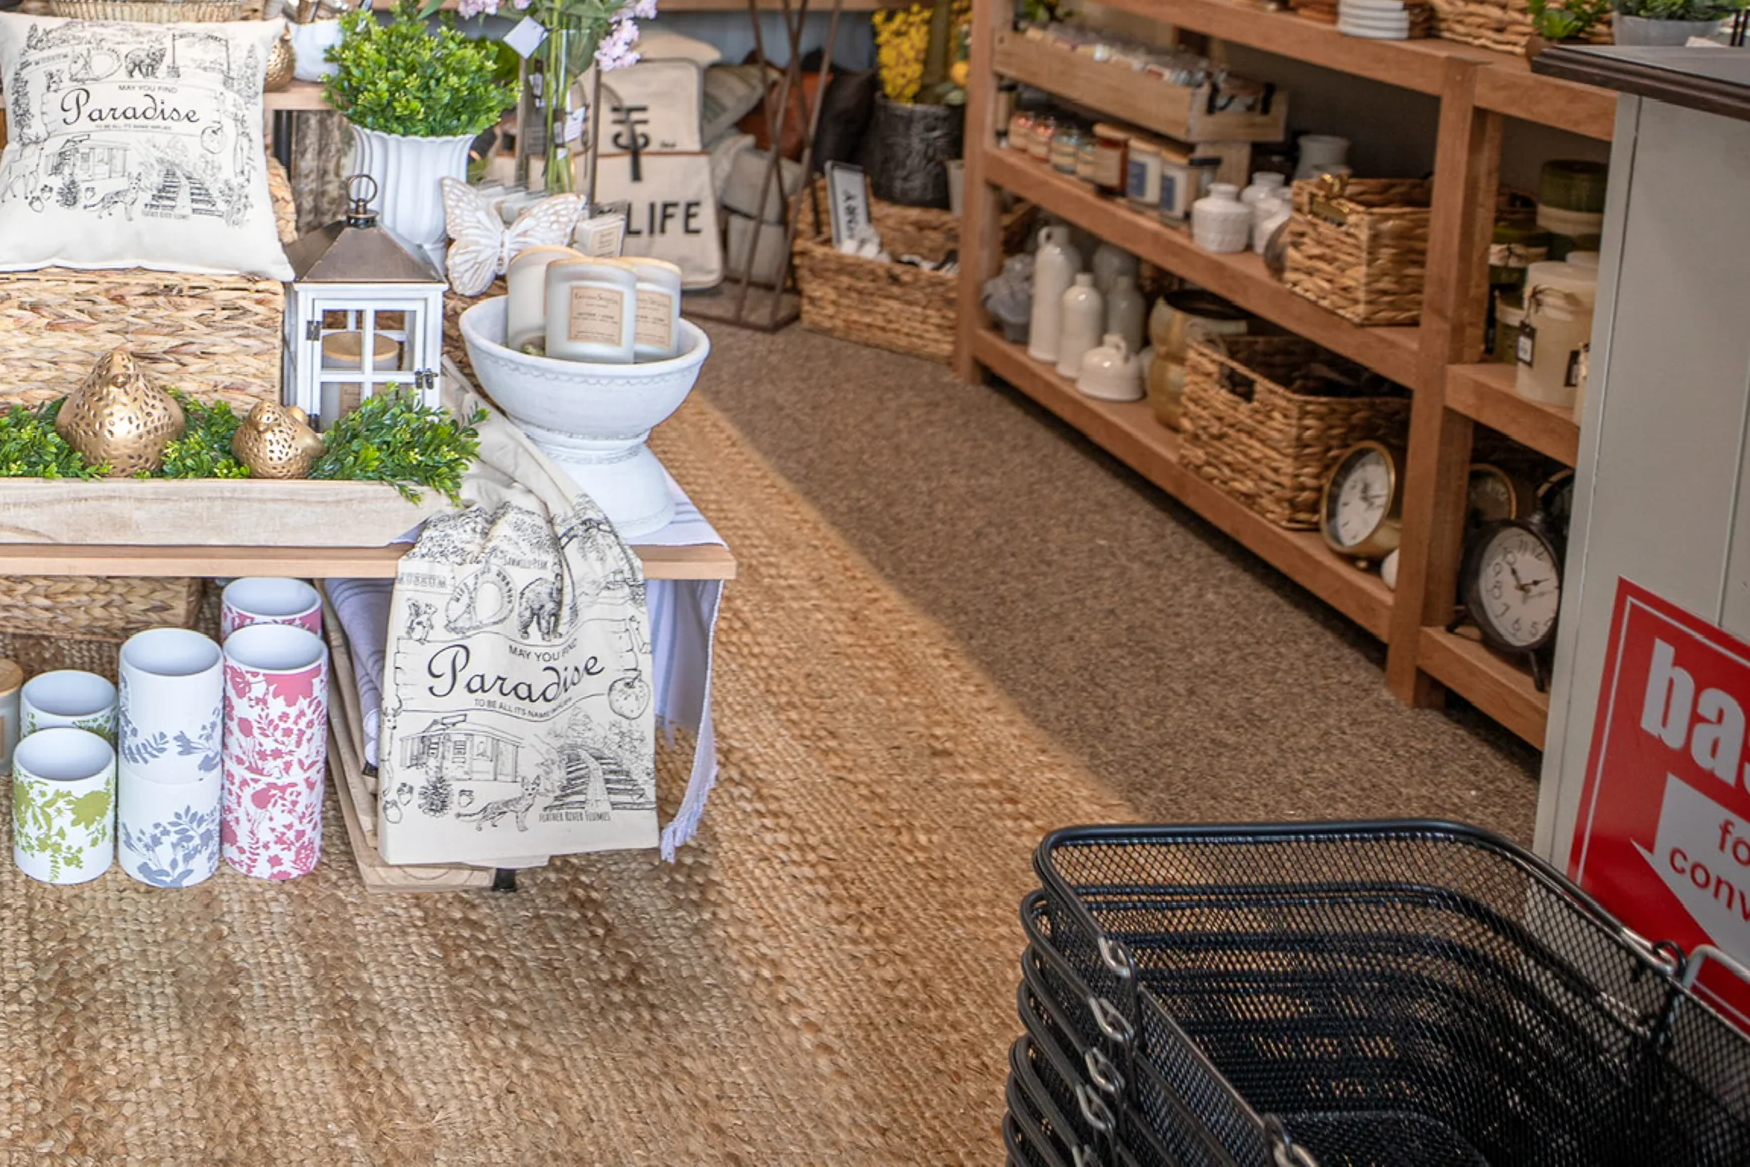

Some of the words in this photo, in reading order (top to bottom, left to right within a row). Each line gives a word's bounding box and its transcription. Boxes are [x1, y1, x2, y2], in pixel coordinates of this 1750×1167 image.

[158, 86, 177, 94] FIND
[60, 88, 200, 125] Paradise
[508, 645, 531, 660] MAY
[535, 652, 561, 662] YOU
[427, 643, 605, 703] Paradise
[474, 698, 486, 707] TO
[486, 700, 497, 709] BE
[498, 702, 513, 712] ALL
[514, 705, 528, 716] ITS
[1640, 638, 1750, 797] ba
